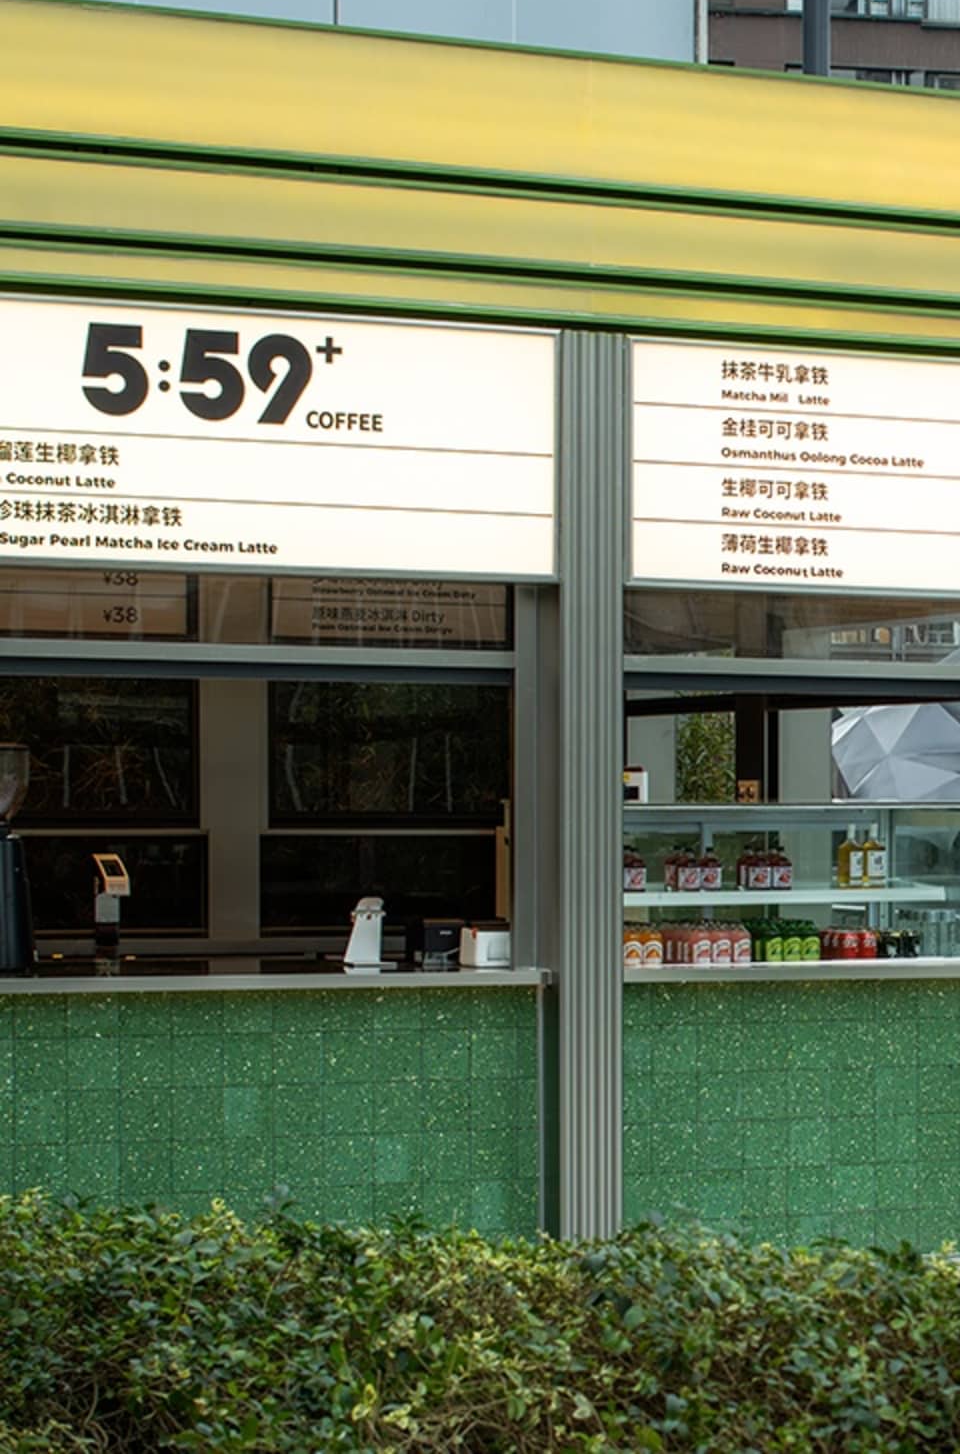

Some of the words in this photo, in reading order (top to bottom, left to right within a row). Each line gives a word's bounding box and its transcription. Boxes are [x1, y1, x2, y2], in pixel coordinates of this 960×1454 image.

[721, 360, 829, 385] 抹茶牛乳拿铁
[721, 389, 767, 402] Matcha
[798, 394, 830, 406] Latte
[306, 411, 383, 432] COFFEE
[721, 417, 828, 441] 金桂可可拿铁
[721, 447, 796, 461] Osmanthus
[800, 451, 847, 467] Oolong
[850, 454, 889, 466] Cocoa
[892, 456, 924, 468] Latte
[6, 472, 71, 487] Coconut
[75, 476, 116, 489] Latte
[721, 478, 828, 501] 生椰可可拿铁
[721, 507, 750, 519] Raw
[753, 508, 806, 521] Coconut
[809, 512, 842, 523] Latte
[0, 532, 45, 548] Sugar
[50, 533, 91, 547] Pearl
[95, 535, 153, 550] Matcha
[157, 538, 180, 551] Ice
[183, 539, 234, 553] Cream
[238, 541, 278, 554] Latte
[721, 533, 829, 557] 薄荷生椰拿铁
[721, 562, 750, 575] Raw
[753, 564, 808, 578] Coconut
[811, 566, 844, 579] Latte
[102, 605, 139, 624] ¥38
[411, 609, 446, 625] Dirty
